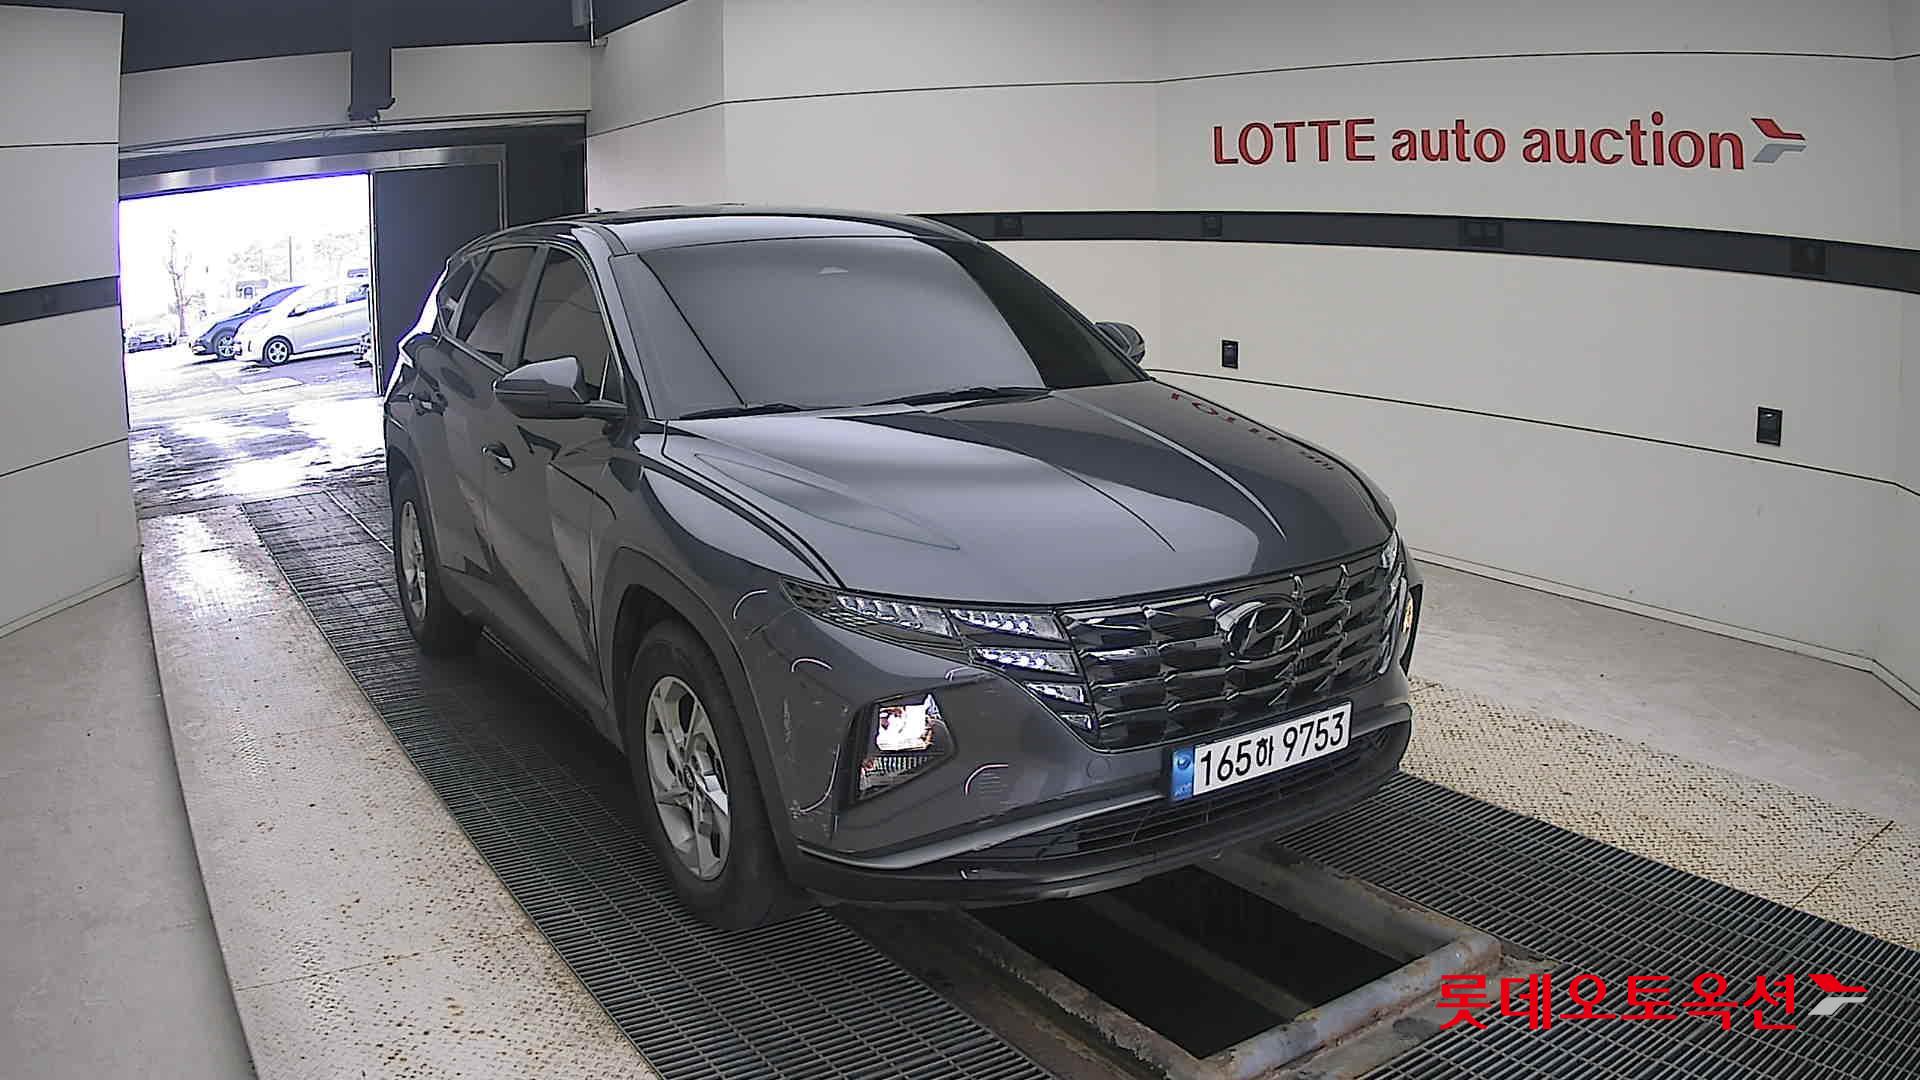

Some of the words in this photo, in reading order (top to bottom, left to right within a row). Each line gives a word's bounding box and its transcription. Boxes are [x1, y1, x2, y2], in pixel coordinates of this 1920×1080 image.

[1212, 118, 1376, 165] LOTTE
[1391, 119, 1506, 162] auto
[1522, 111, 1744, 170] auction
[1200, 735, 1274, 786] 165하
[1282, 711, 1345, 761] 9753
